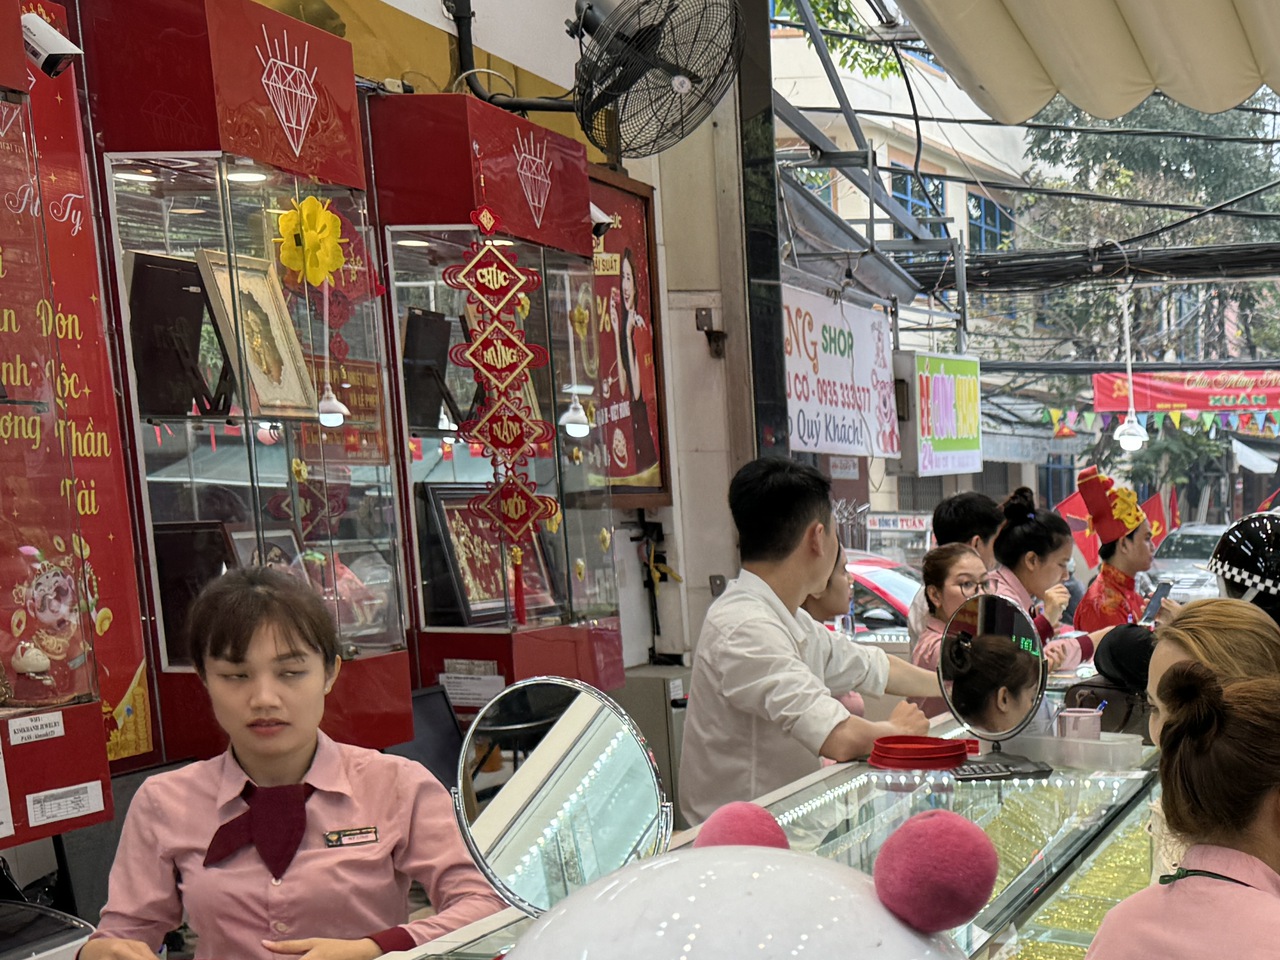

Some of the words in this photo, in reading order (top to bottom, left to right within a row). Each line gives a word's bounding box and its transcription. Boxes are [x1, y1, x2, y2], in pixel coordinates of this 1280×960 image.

[476, 263, 510, 290] CHÚC
[36, 299, 83, 340] Đón
[483, 340, 518, 370] MỪNG
[816, 378, 839, 407] 0935
[1209, 394, 1267, 406] XUÂN
[54, 417, 111, 457] Thần
[493, 415, 521, 444] NĂM
[797, 409, 821, 448] Quý
[824, 412, 864, 446] Khách!
[60, 478, 99, 515] Tài
[501, 492, 526, 520] MỚI
